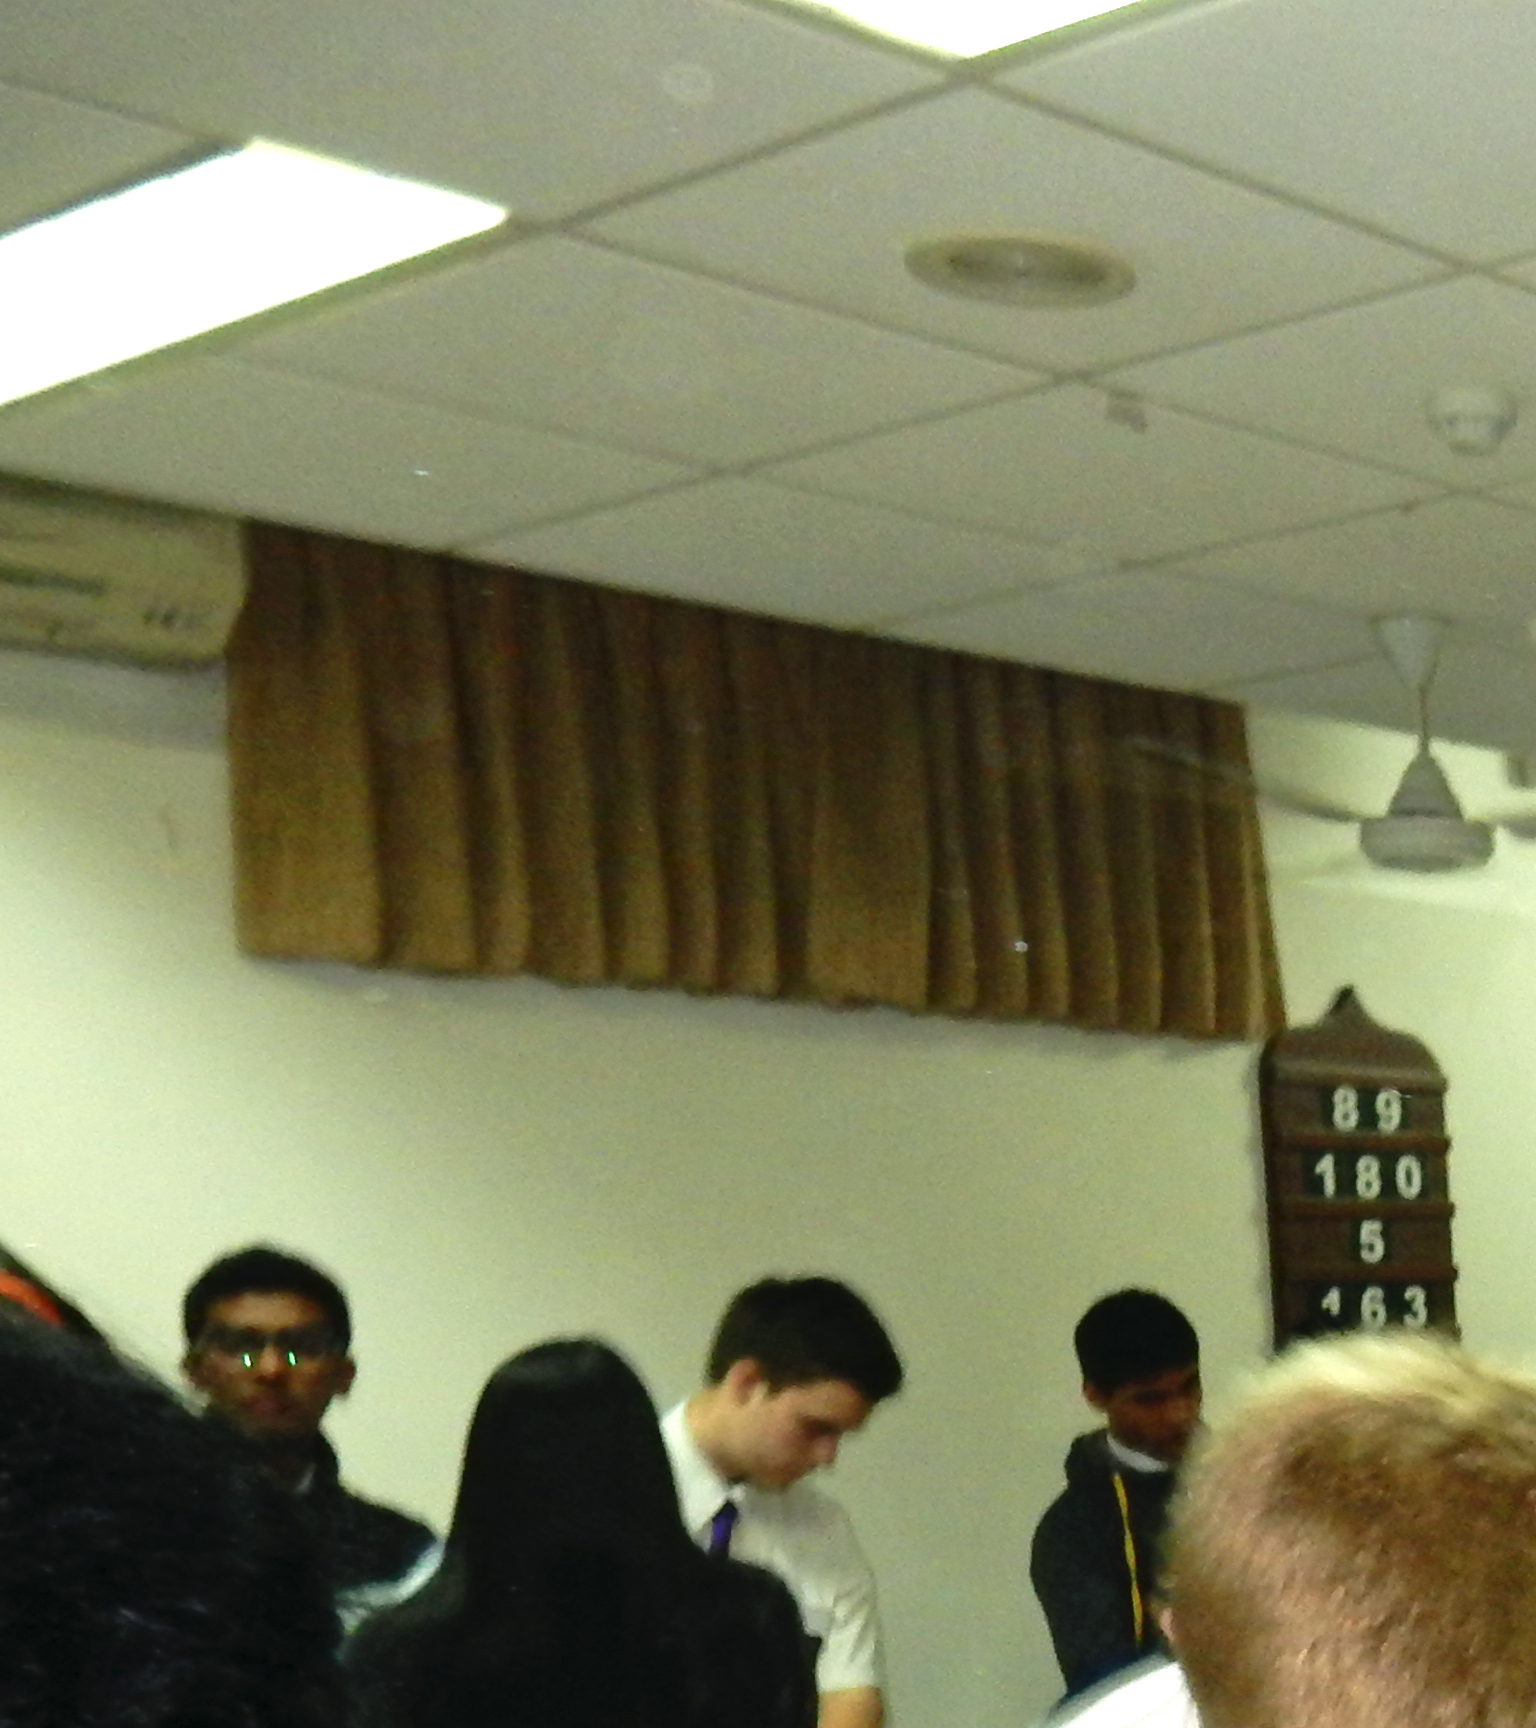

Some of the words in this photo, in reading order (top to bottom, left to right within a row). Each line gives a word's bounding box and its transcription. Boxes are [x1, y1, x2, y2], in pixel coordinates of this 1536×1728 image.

[1332, 1086, 1403, 1134] 89
[1315, 1153, 1423, 1200] 180
[1359, 1219, 1386, 1264] 5
[1321, 1285, 1427, 1329] 163
